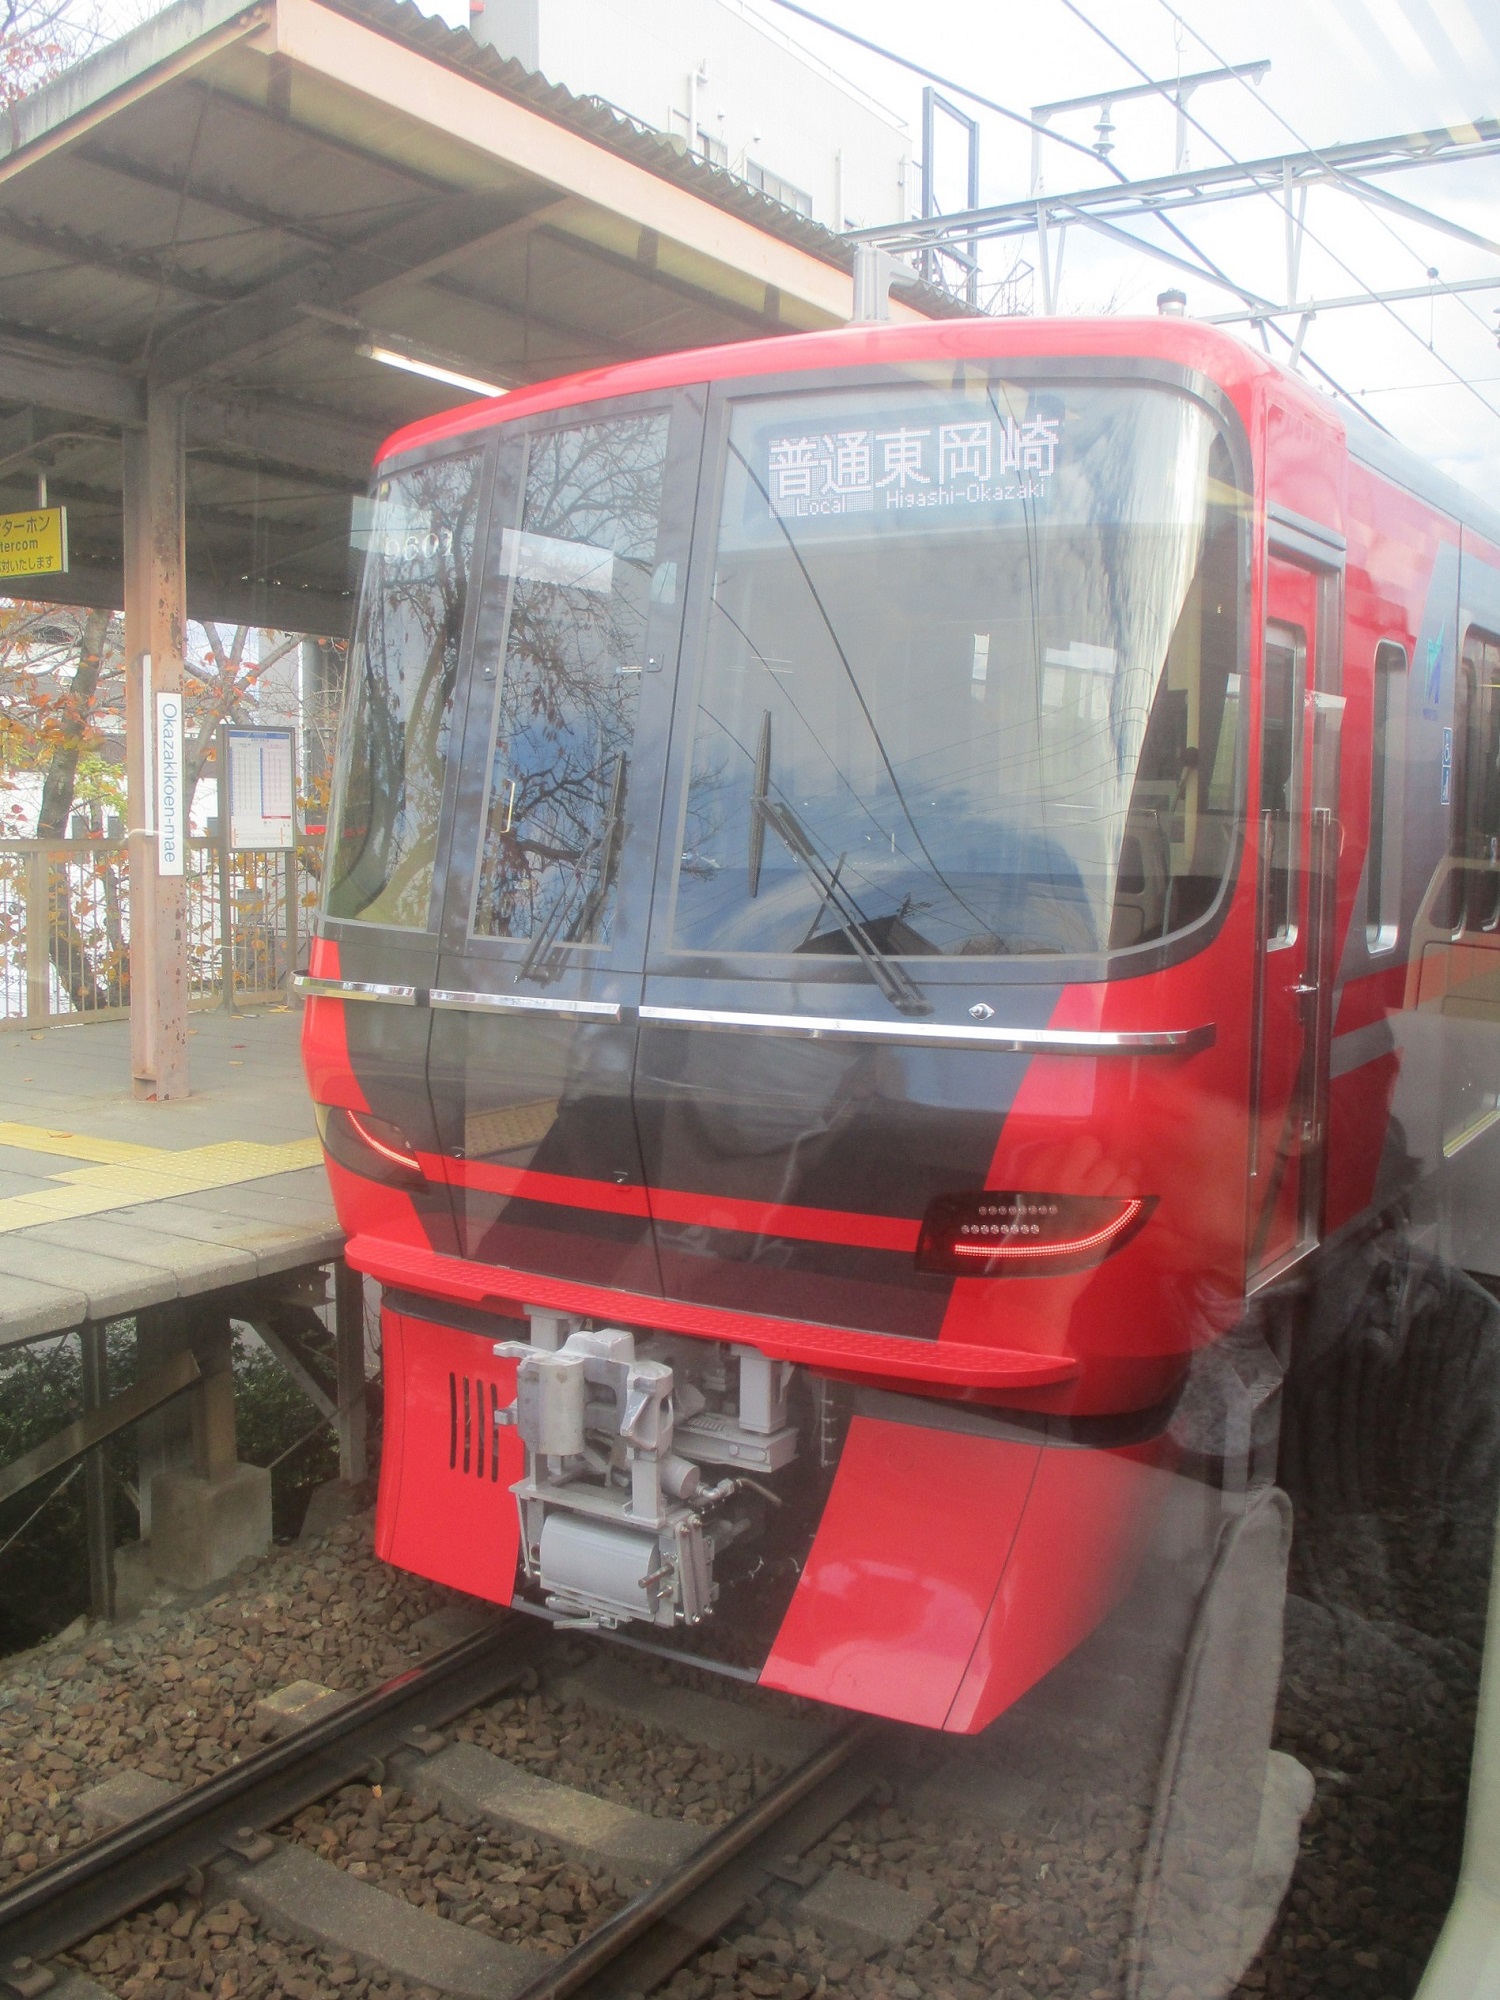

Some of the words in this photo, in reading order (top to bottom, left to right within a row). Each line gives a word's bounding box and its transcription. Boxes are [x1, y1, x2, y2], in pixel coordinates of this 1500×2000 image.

[769, 430, 873, 498] 普通
[876, 414, 1059, 488] 東岡崎
[796, 495, 846, 516] Local
[886, 479, 1045, 509] Higashi-Okazaki
[0, 516, 50, 537] ターホン
[383, 526, 454, 564] 9601
[0, 556, 54, 573] 対いたします
